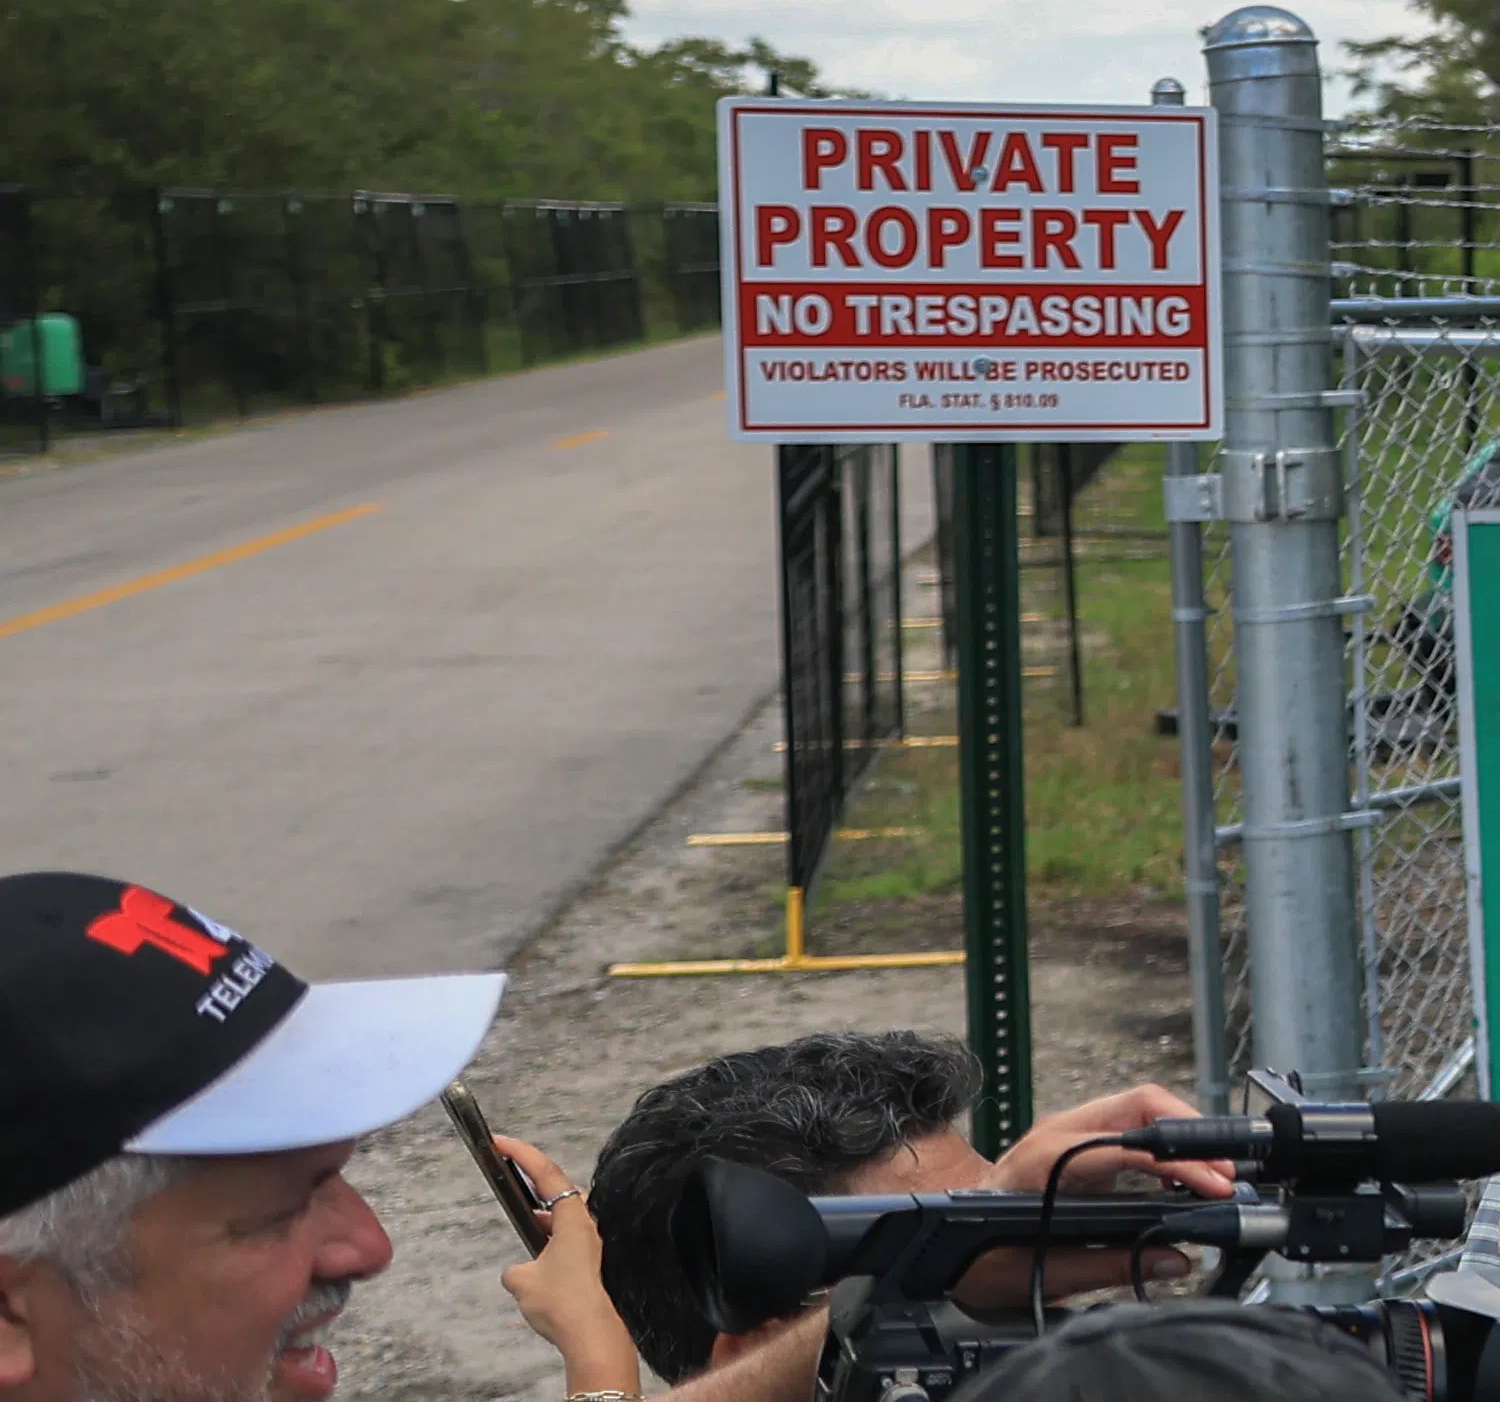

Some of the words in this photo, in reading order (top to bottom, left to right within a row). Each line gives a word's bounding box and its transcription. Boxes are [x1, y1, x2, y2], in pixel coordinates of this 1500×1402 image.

[801, 127, 1140, 195] PRIVATE
[755, 204, 1185, 271] PROPERTY
[755, 294, 832, 337] NO
[845, 294, 1191, 338] TRESPASSING
[760, 361, 906, 382] VIOLATORS
[914, 361, 976, 382] WILL
[985, 362, 1016, 382] BE
[1025, 362, 1190, 382] PROSECUTED
[899, 393, 933, 409] FLA.
[940, 393, 984, 409] STAT.
